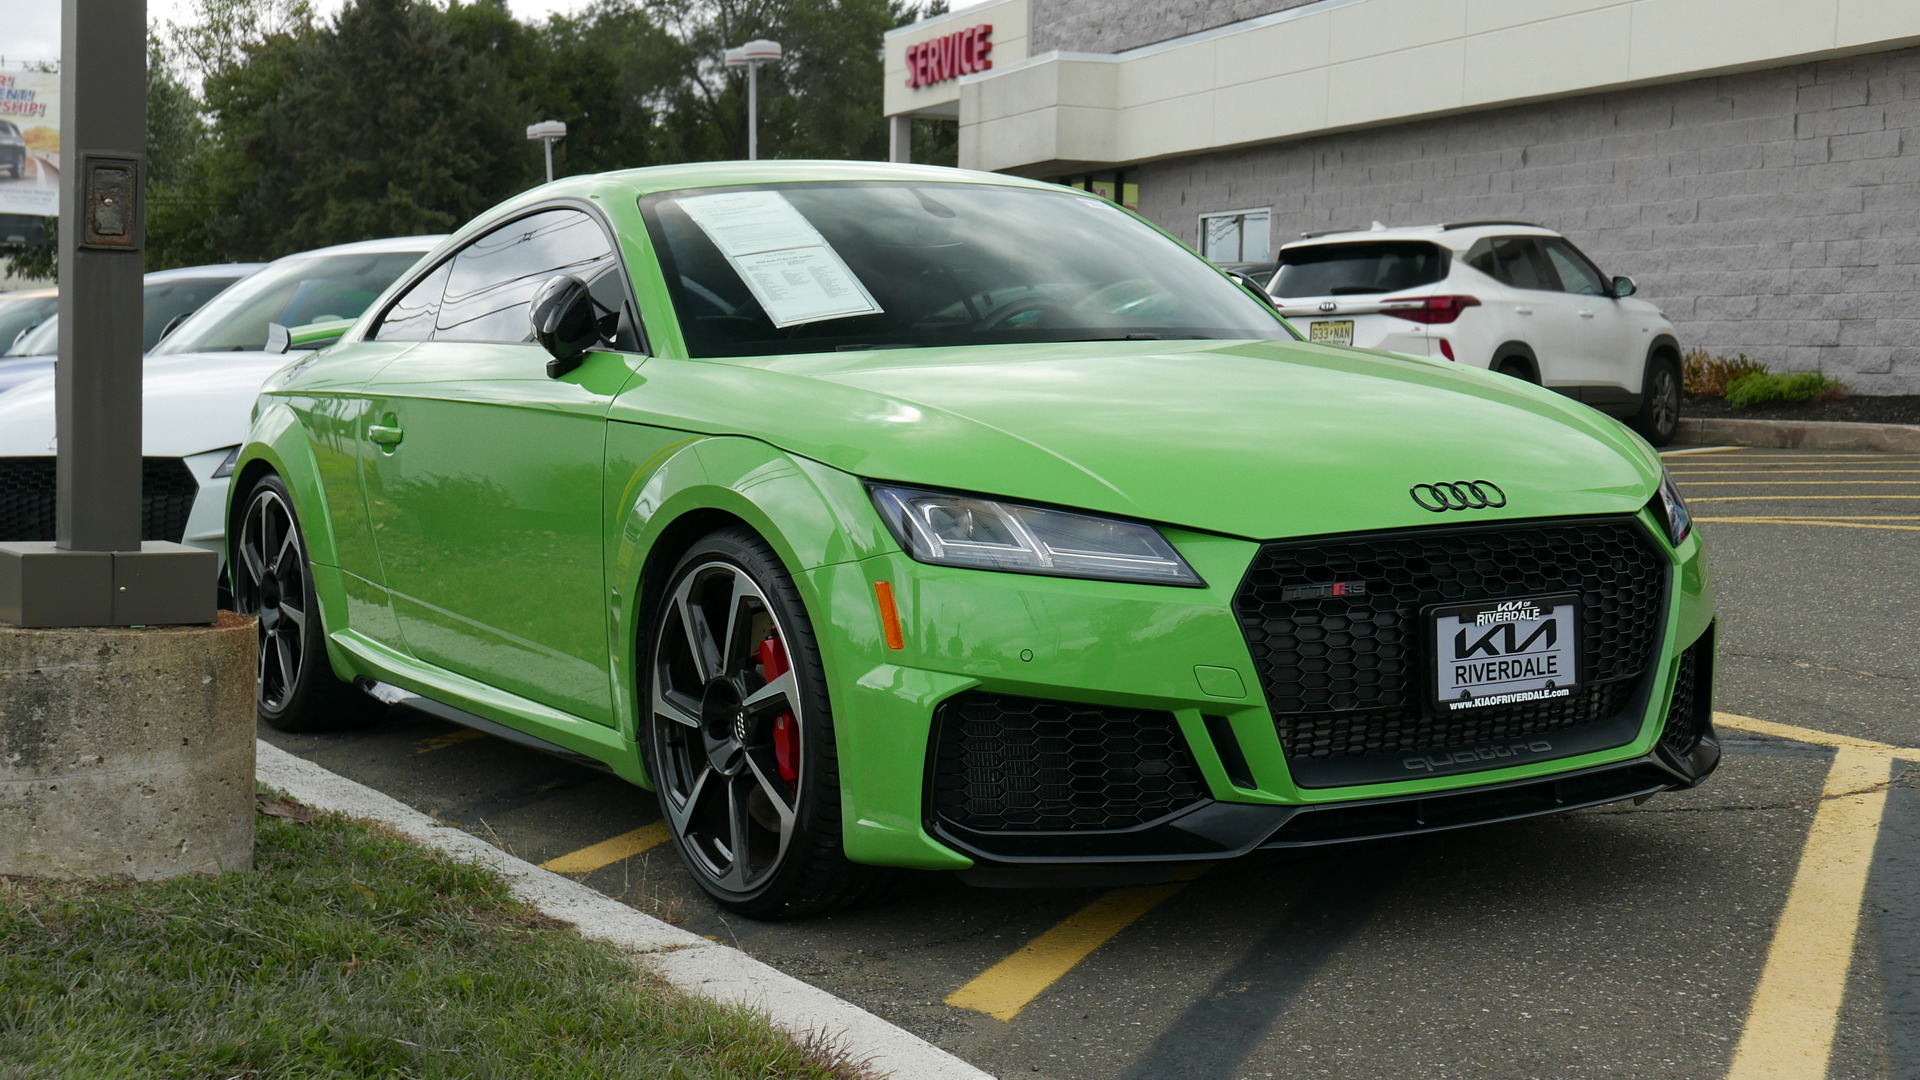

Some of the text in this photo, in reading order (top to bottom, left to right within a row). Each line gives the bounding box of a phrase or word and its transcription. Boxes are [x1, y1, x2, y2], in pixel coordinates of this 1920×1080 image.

[905, 24, 992, 88] SERVICE
[0, 101, 46, 116] SHIP!
[1320, 302, 1336, 311] KIA
[1476, 608, 1541, 627] RIVERDALE
[1497, 601, 1523, 612] KIA
[1454, 618, 1557, 660] KIA
[1455, 655, 1558, 685] RIVERDALE
[1449, 689, 1570, 711] www.KIAOFRIVERDALE.com
[1402, 740, 1553, 772] quattro
